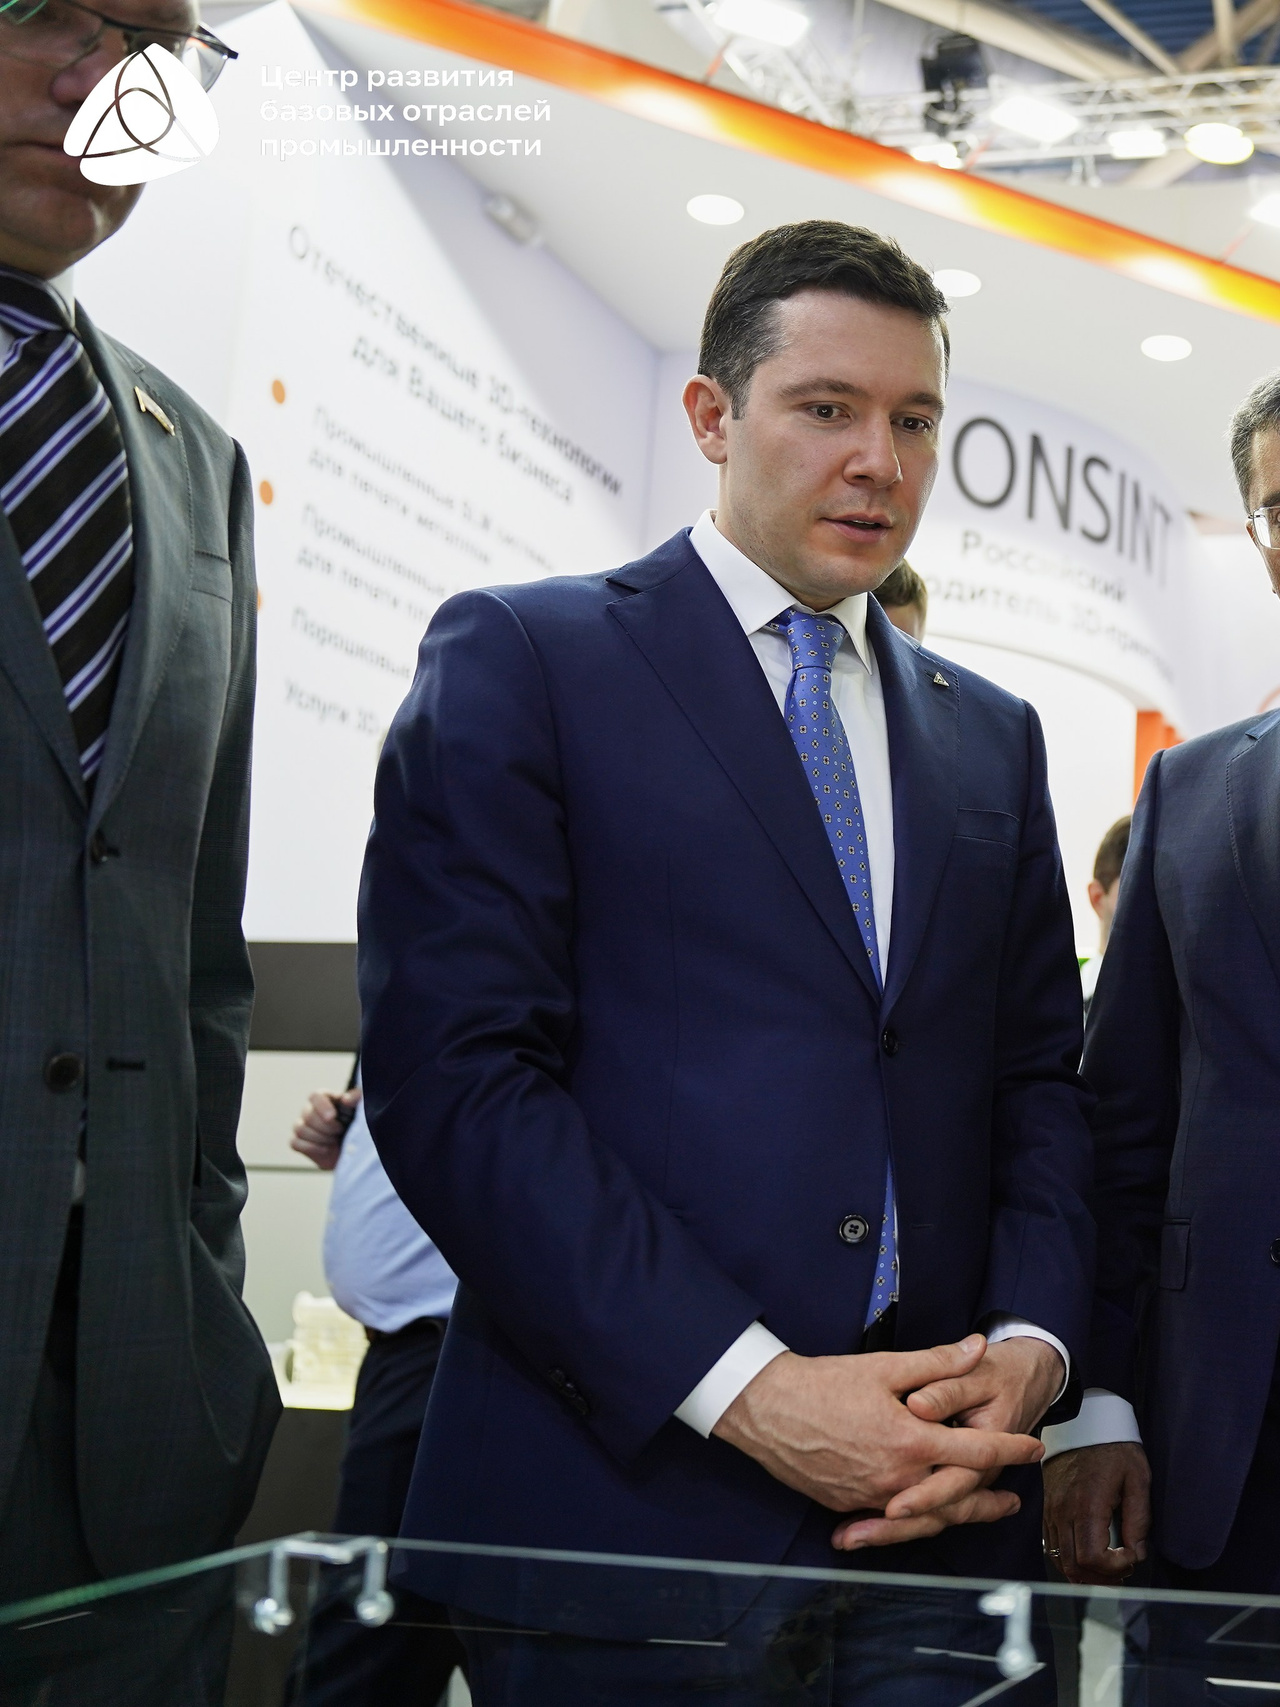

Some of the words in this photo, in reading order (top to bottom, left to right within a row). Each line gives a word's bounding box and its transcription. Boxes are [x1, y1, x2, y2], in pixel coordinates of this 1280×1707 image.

[289, 225, 480, 390] Отечественные
[352, 334, 398, 380] для
[408, 363, 490, 448] Вашего
[496, 429, 574, 504] бизнеса
[952, 416, 1174, 589] ONSINT
[961, 528, 1128, 604] Российский
[926, 575, 1062, 628] одитель
